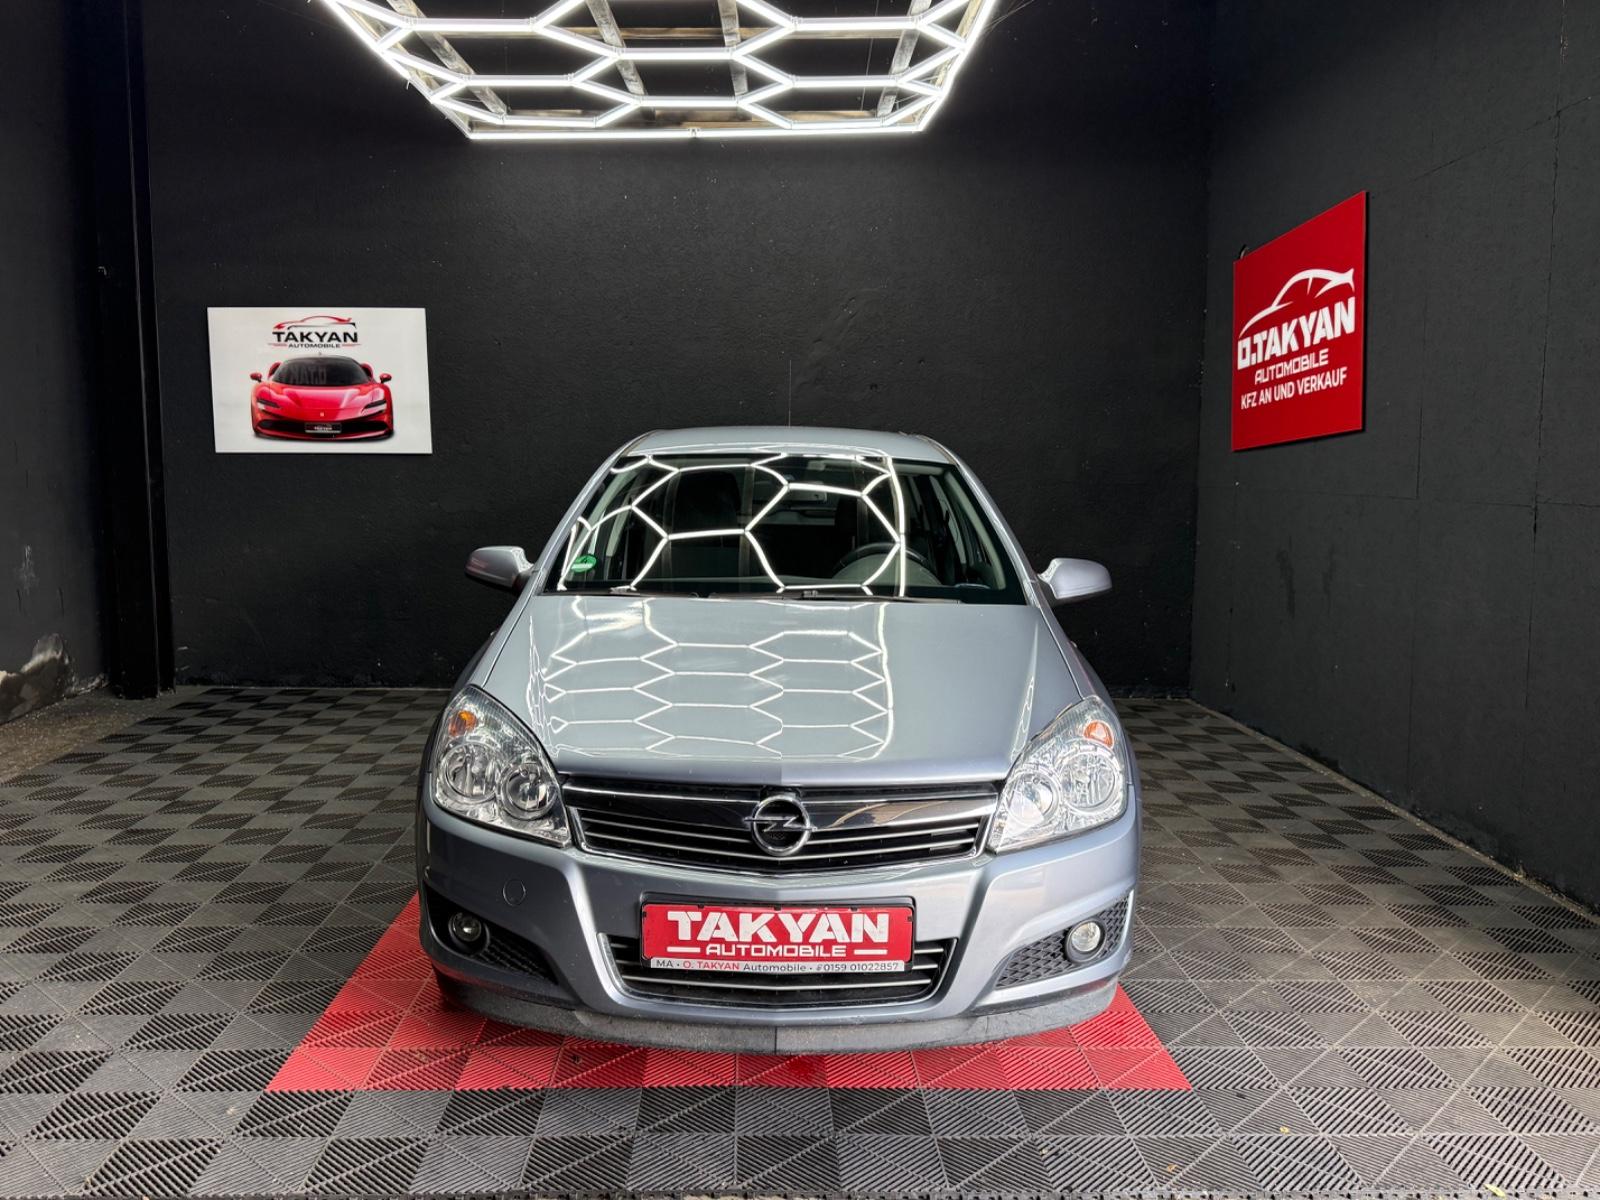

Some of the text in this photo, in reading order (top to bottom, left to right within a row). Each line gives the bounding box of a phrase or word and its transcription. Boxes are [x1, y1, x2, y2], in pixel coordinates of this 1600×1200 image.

[272, 331, 359, 343] TAKYAN
[1254, 348, 1329, 385] AUTOMOBILE
[1240, 366, 1348, 410] KFZ AN UND VERKAUF
[667, 911, 889, 943] TAKYAN
[705, 943, 847, 957] AUTOMOBILE
[655, 959, 674, 968] MA
[682, 960, 694, 969] O.
[697, 961, 740, 970] TAKYAN
[743, 962, 807, 972] Automobile
[849, 962, 899, 972] 01022857
